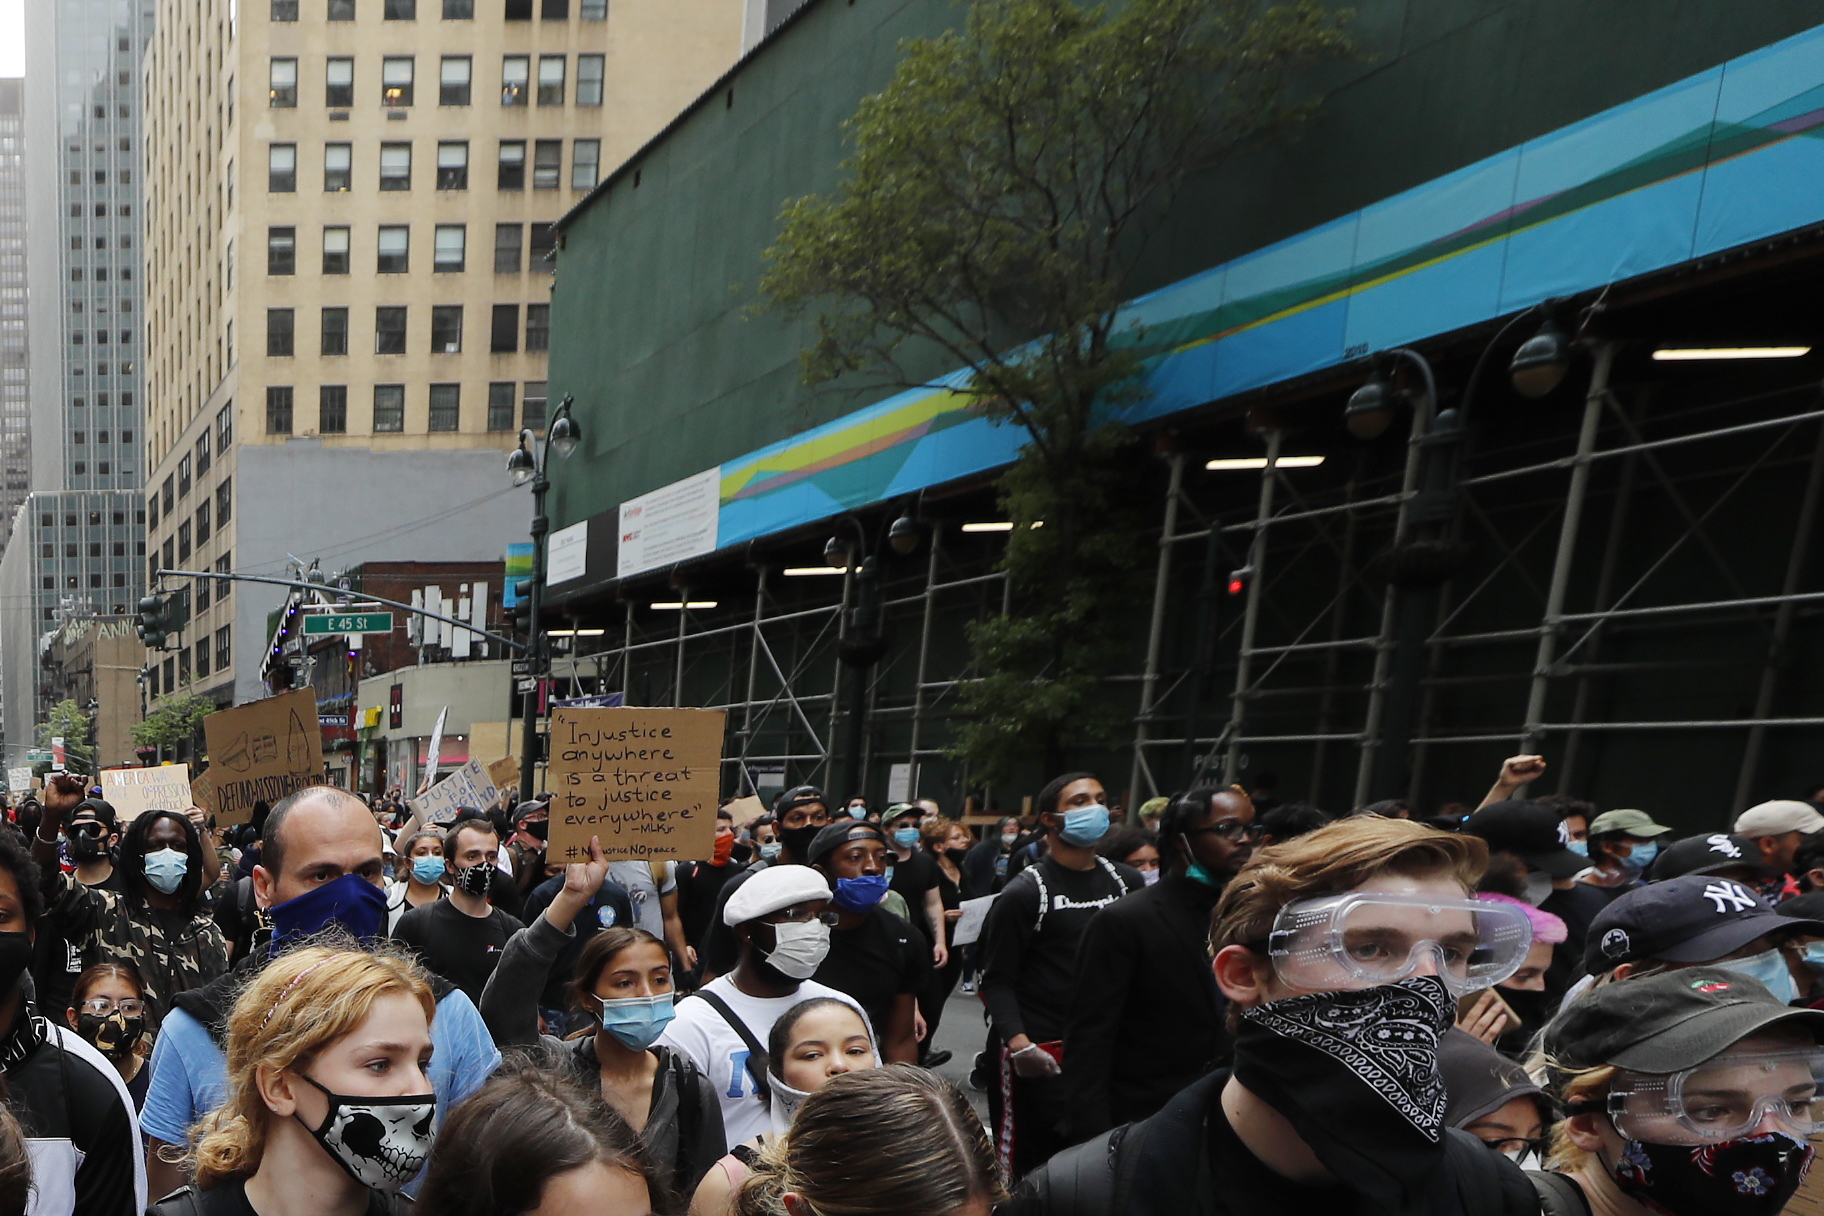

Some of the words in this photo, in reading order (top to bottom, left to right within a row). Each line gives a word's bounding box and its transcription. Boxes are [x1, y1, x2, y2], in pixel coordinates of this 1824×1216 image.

[328, 618, 335, 630] E
[338, 618, 353, 631] 45
[356, 617, 368, 630] St
[562, 746, 674, 772] anywhere
[106, 771, 150, 787] AMERICA
[420, 760, 480, 809] JUSTICE
[566, 772, 581, 785] is
[592, 773, 606, 782] a
[613, 766, 691, 785] threat
[565, 791, 587, 808] to
[598, 784, 673, 810] justice
[1703, 881, 1756, 914] NY
